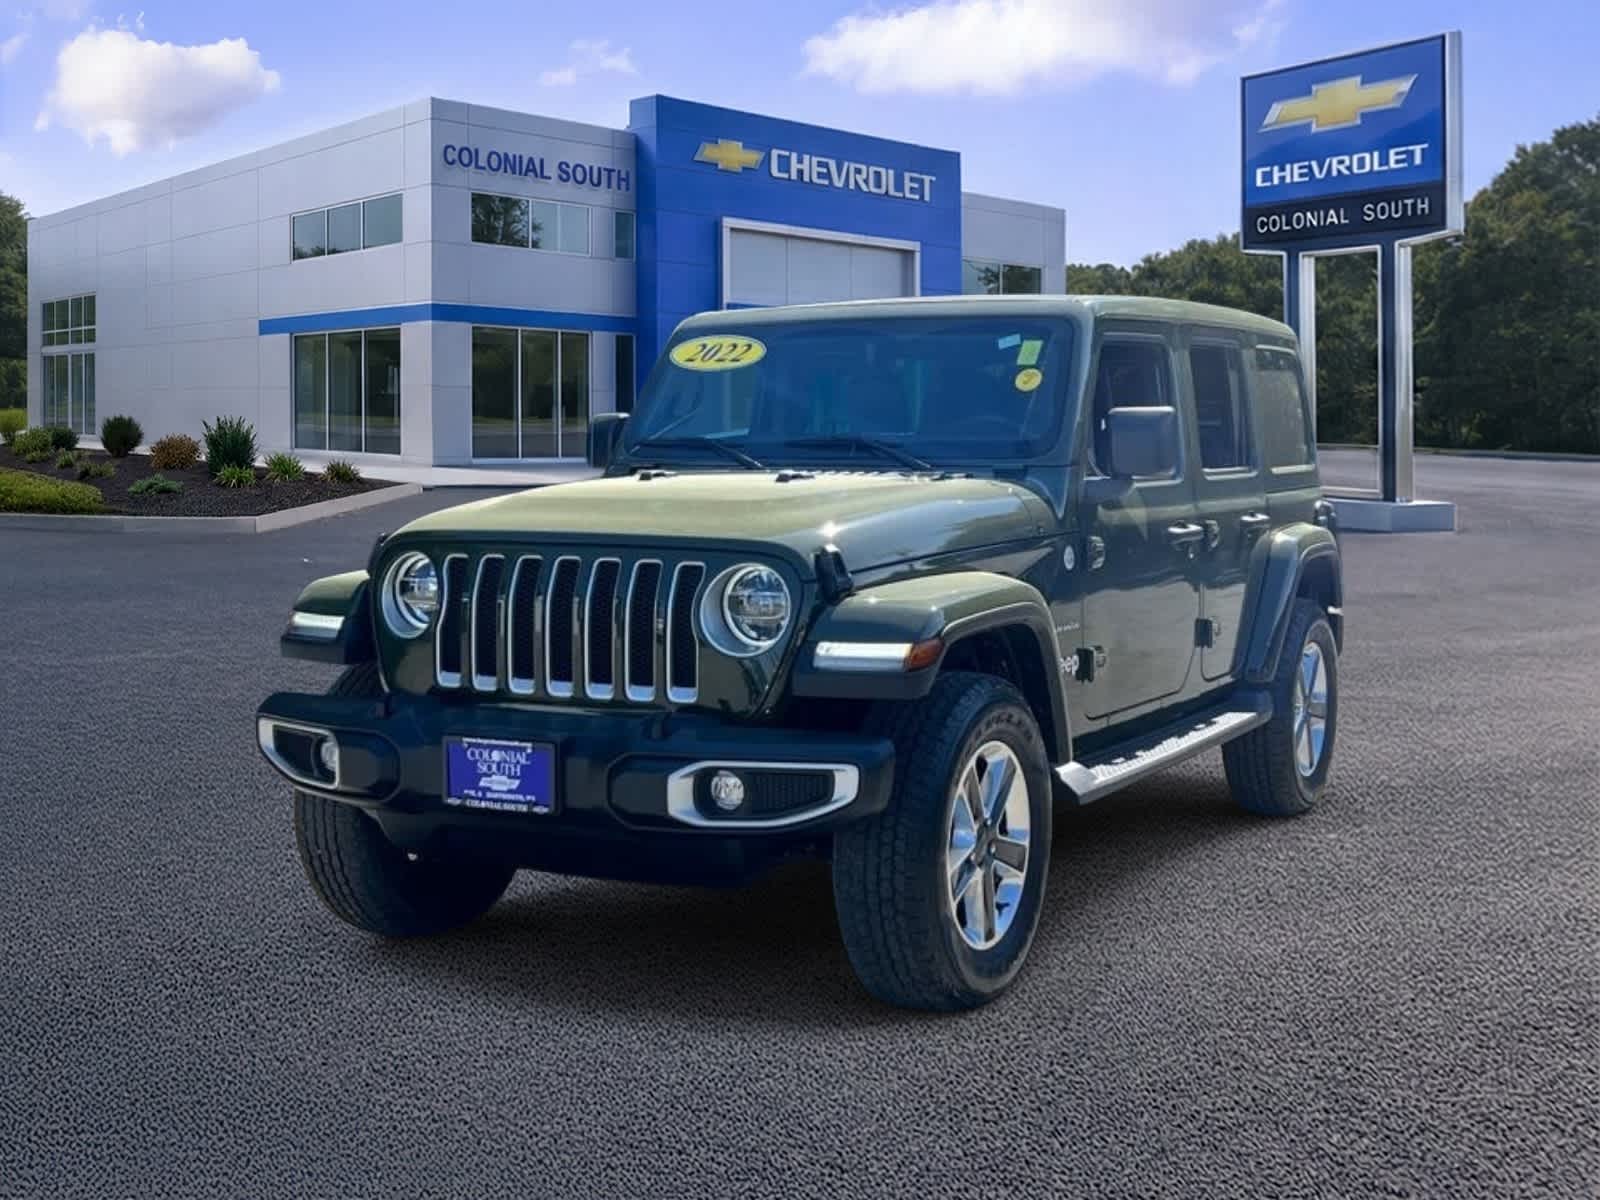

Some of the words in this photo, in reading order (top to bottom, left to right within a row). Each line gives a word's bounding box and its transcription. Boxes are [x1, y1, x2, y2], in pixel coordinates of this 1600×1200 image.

[442, 143, 552, 181] COLONIAL
[557, 161, 631, 192] SOUTH
[769, 148, 936, 202] CHEVROLET
[1255, 143, 1429, 187] CHEVROLET
[1256, 207, 1349, 234] COLONIAL
[1362, 197, 1430, 222] SOUTH
[685, 342, 753, 362] 2022
[466, 747, 532, 765] COLONIAL
[477, 761, 521, 777] SOUTH
